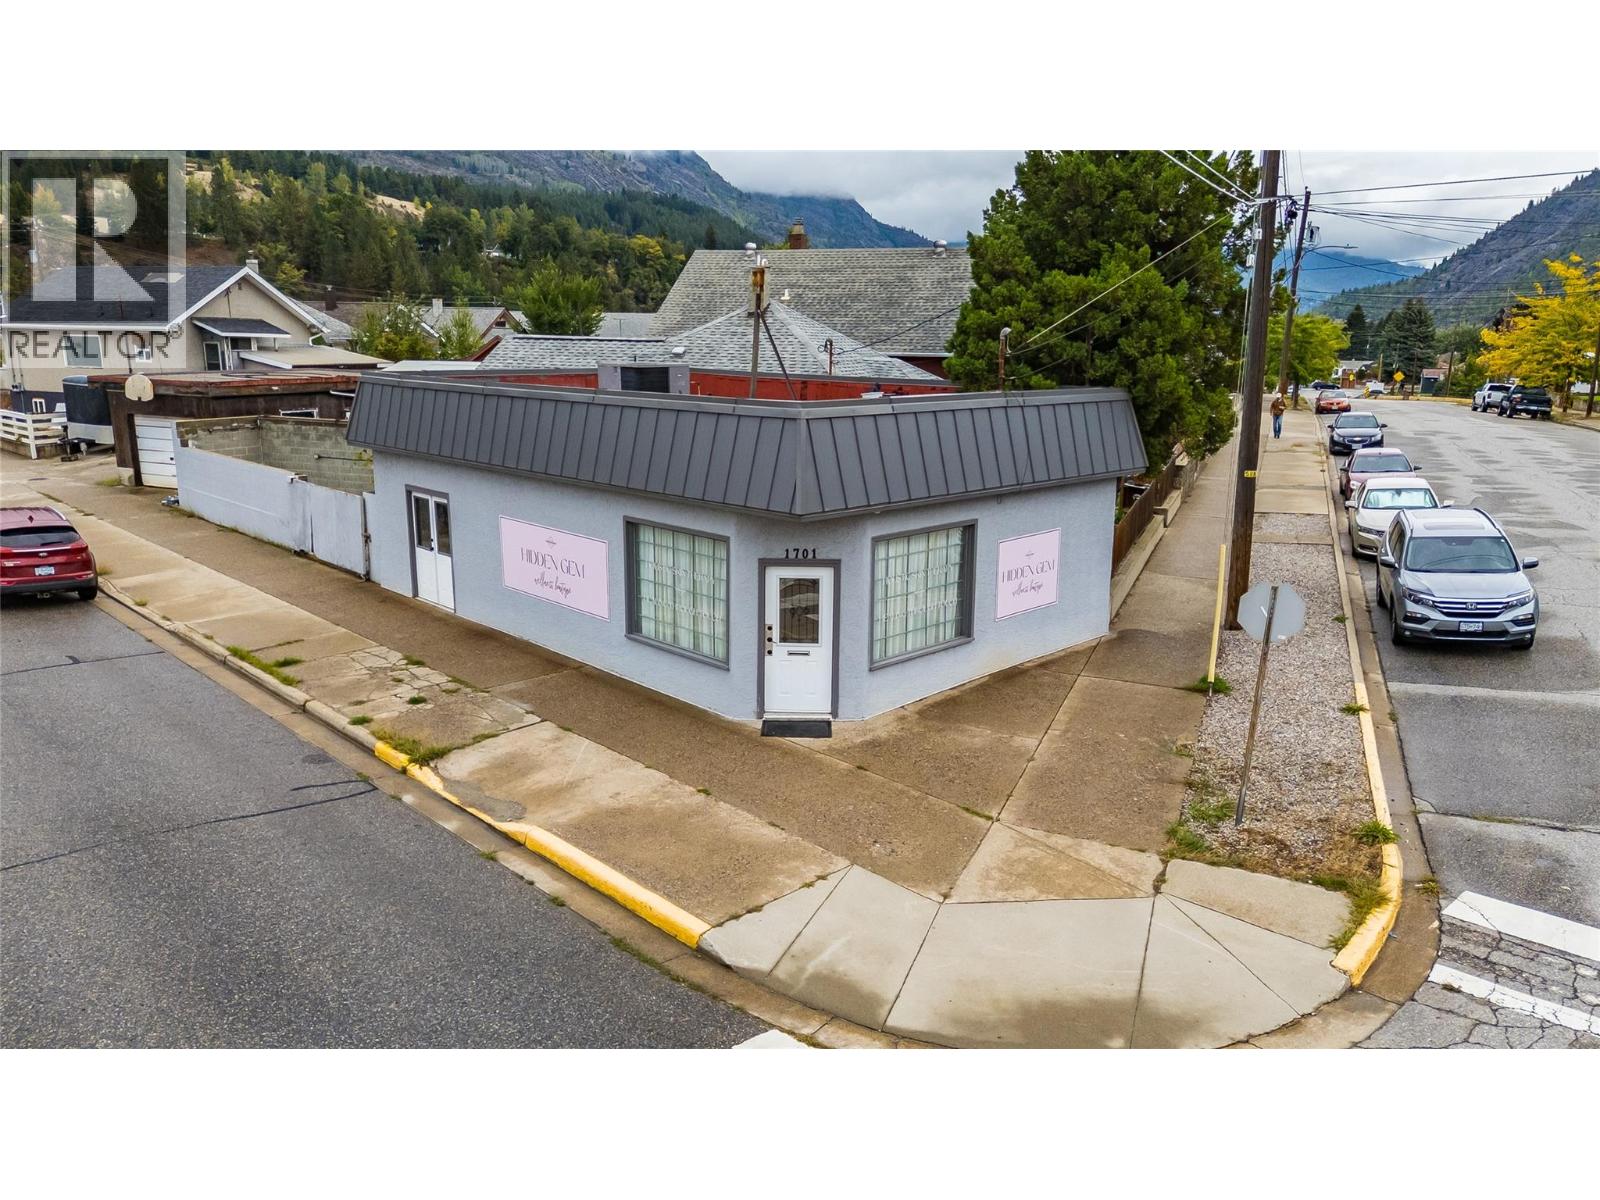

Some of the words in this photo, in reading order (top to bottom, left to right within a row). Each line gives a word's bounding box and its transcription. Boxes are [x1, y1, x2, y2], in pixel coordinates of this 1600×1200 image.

[520, 547, 558, 571] HIDDEN
[560, 558, 585, 579] GEM
[785, 548, 817, 560] 1701
[1001, 564, 1034, 584] HIDDEN
[1035, 559, 1055, 576] GEM
